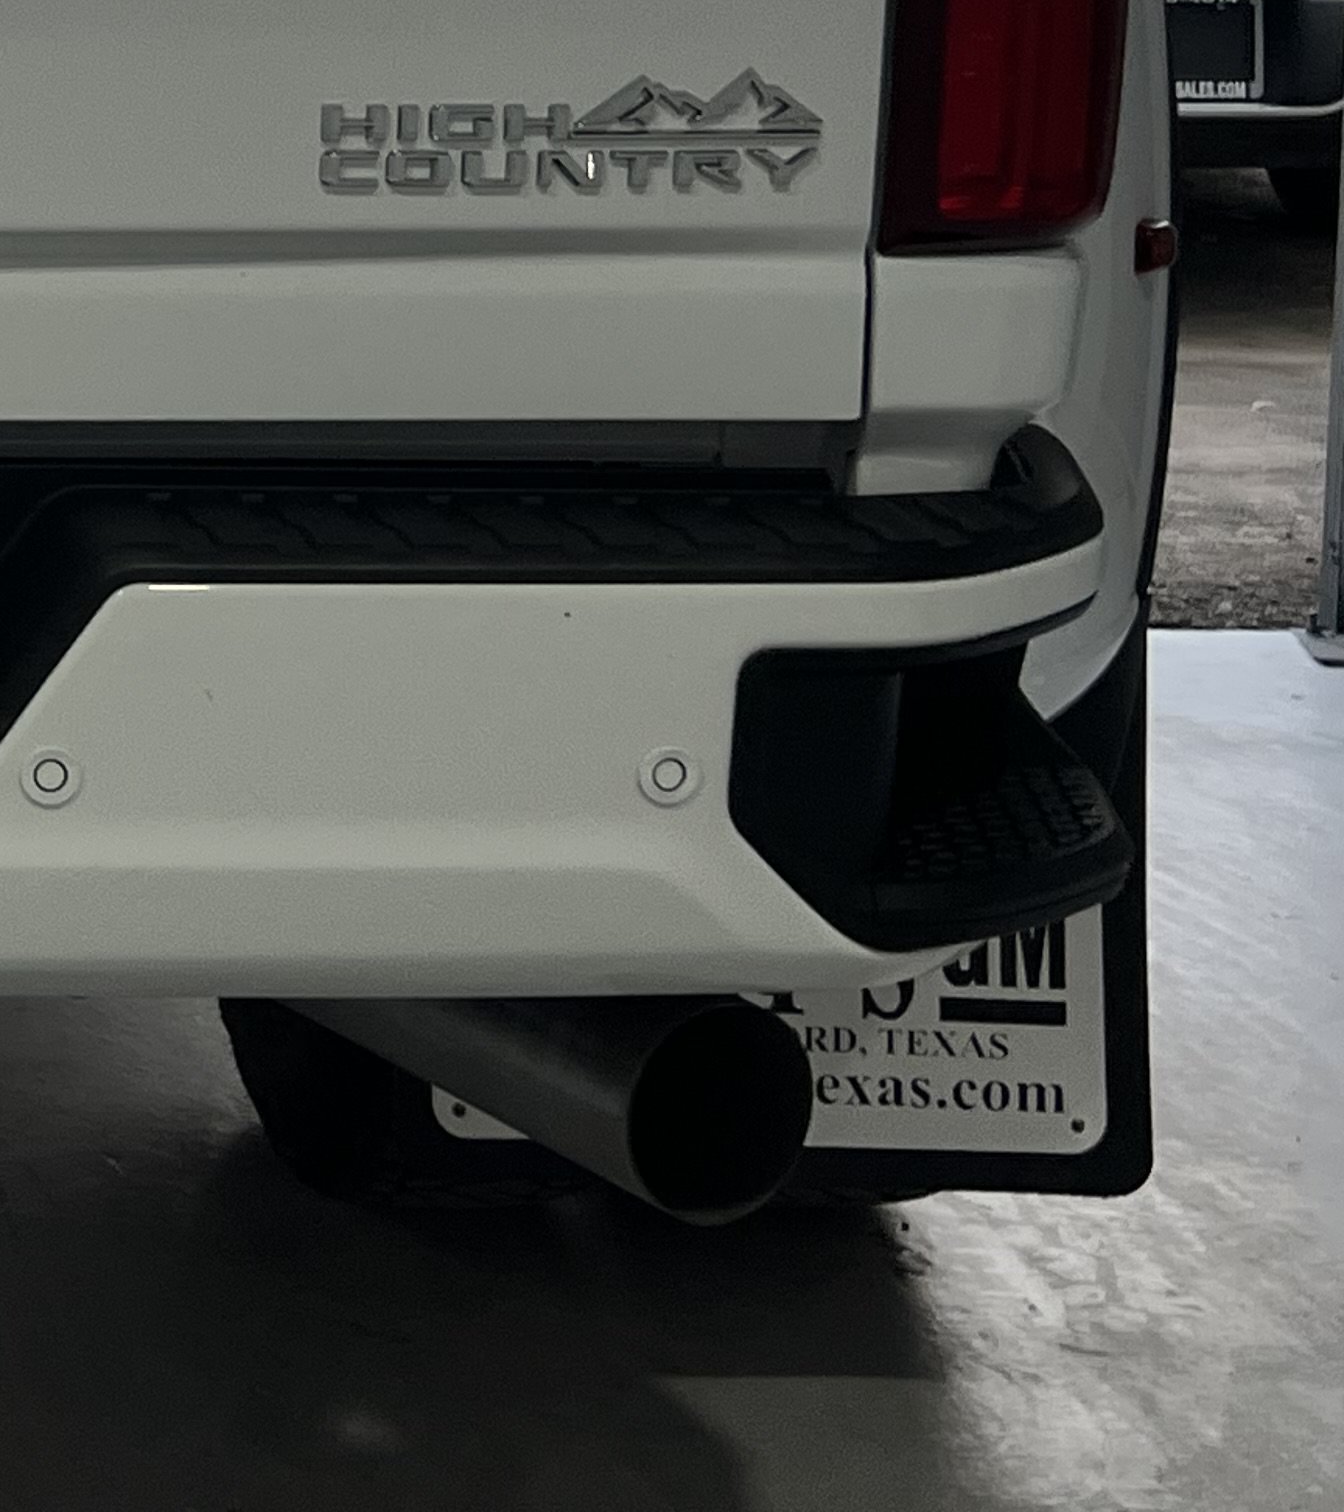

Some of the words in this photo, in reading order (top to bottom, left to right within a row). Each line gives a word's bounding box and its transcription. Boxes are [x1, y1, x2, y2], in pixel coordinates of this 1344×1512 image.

[320, 104, 570, 144] HIGH
[319, 148, 818, 194] COUNTRY
[876, 1028, 1010, 1061] TEXAS
[814, 1072, 1066, 1114] exas.com
